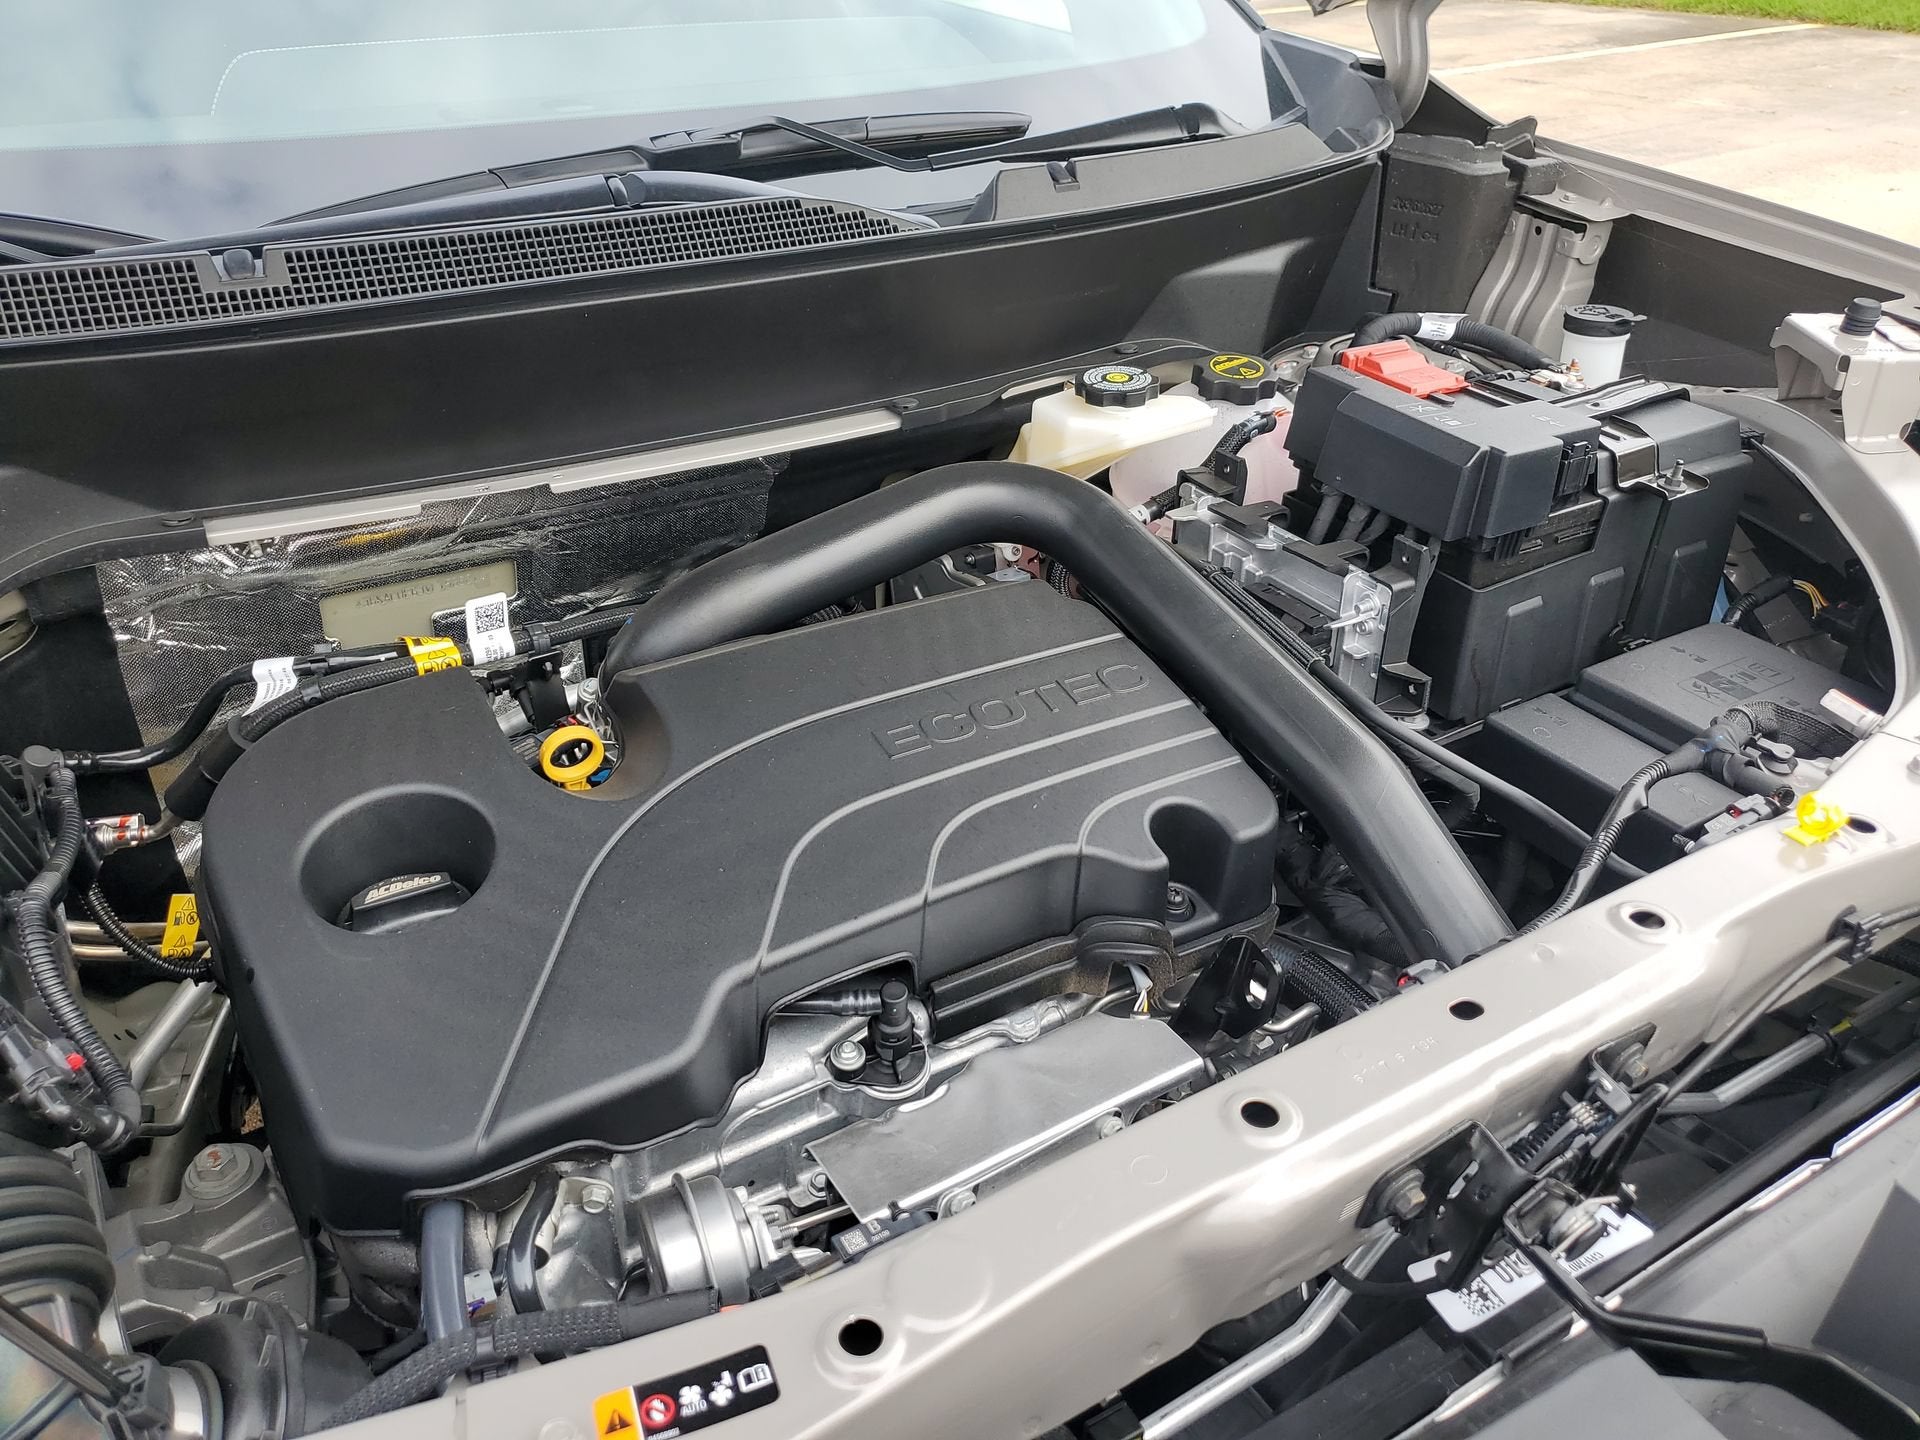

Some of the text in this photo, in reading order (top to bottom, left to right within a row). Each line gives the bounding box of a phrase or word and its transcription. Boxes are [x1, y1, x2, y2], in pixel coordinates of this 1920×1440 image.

[871, 664, 1151, 760] ECOTEC
[364, 875, 442, 903] ACDelco
[680, 1399, 708, 1417] AUTO
